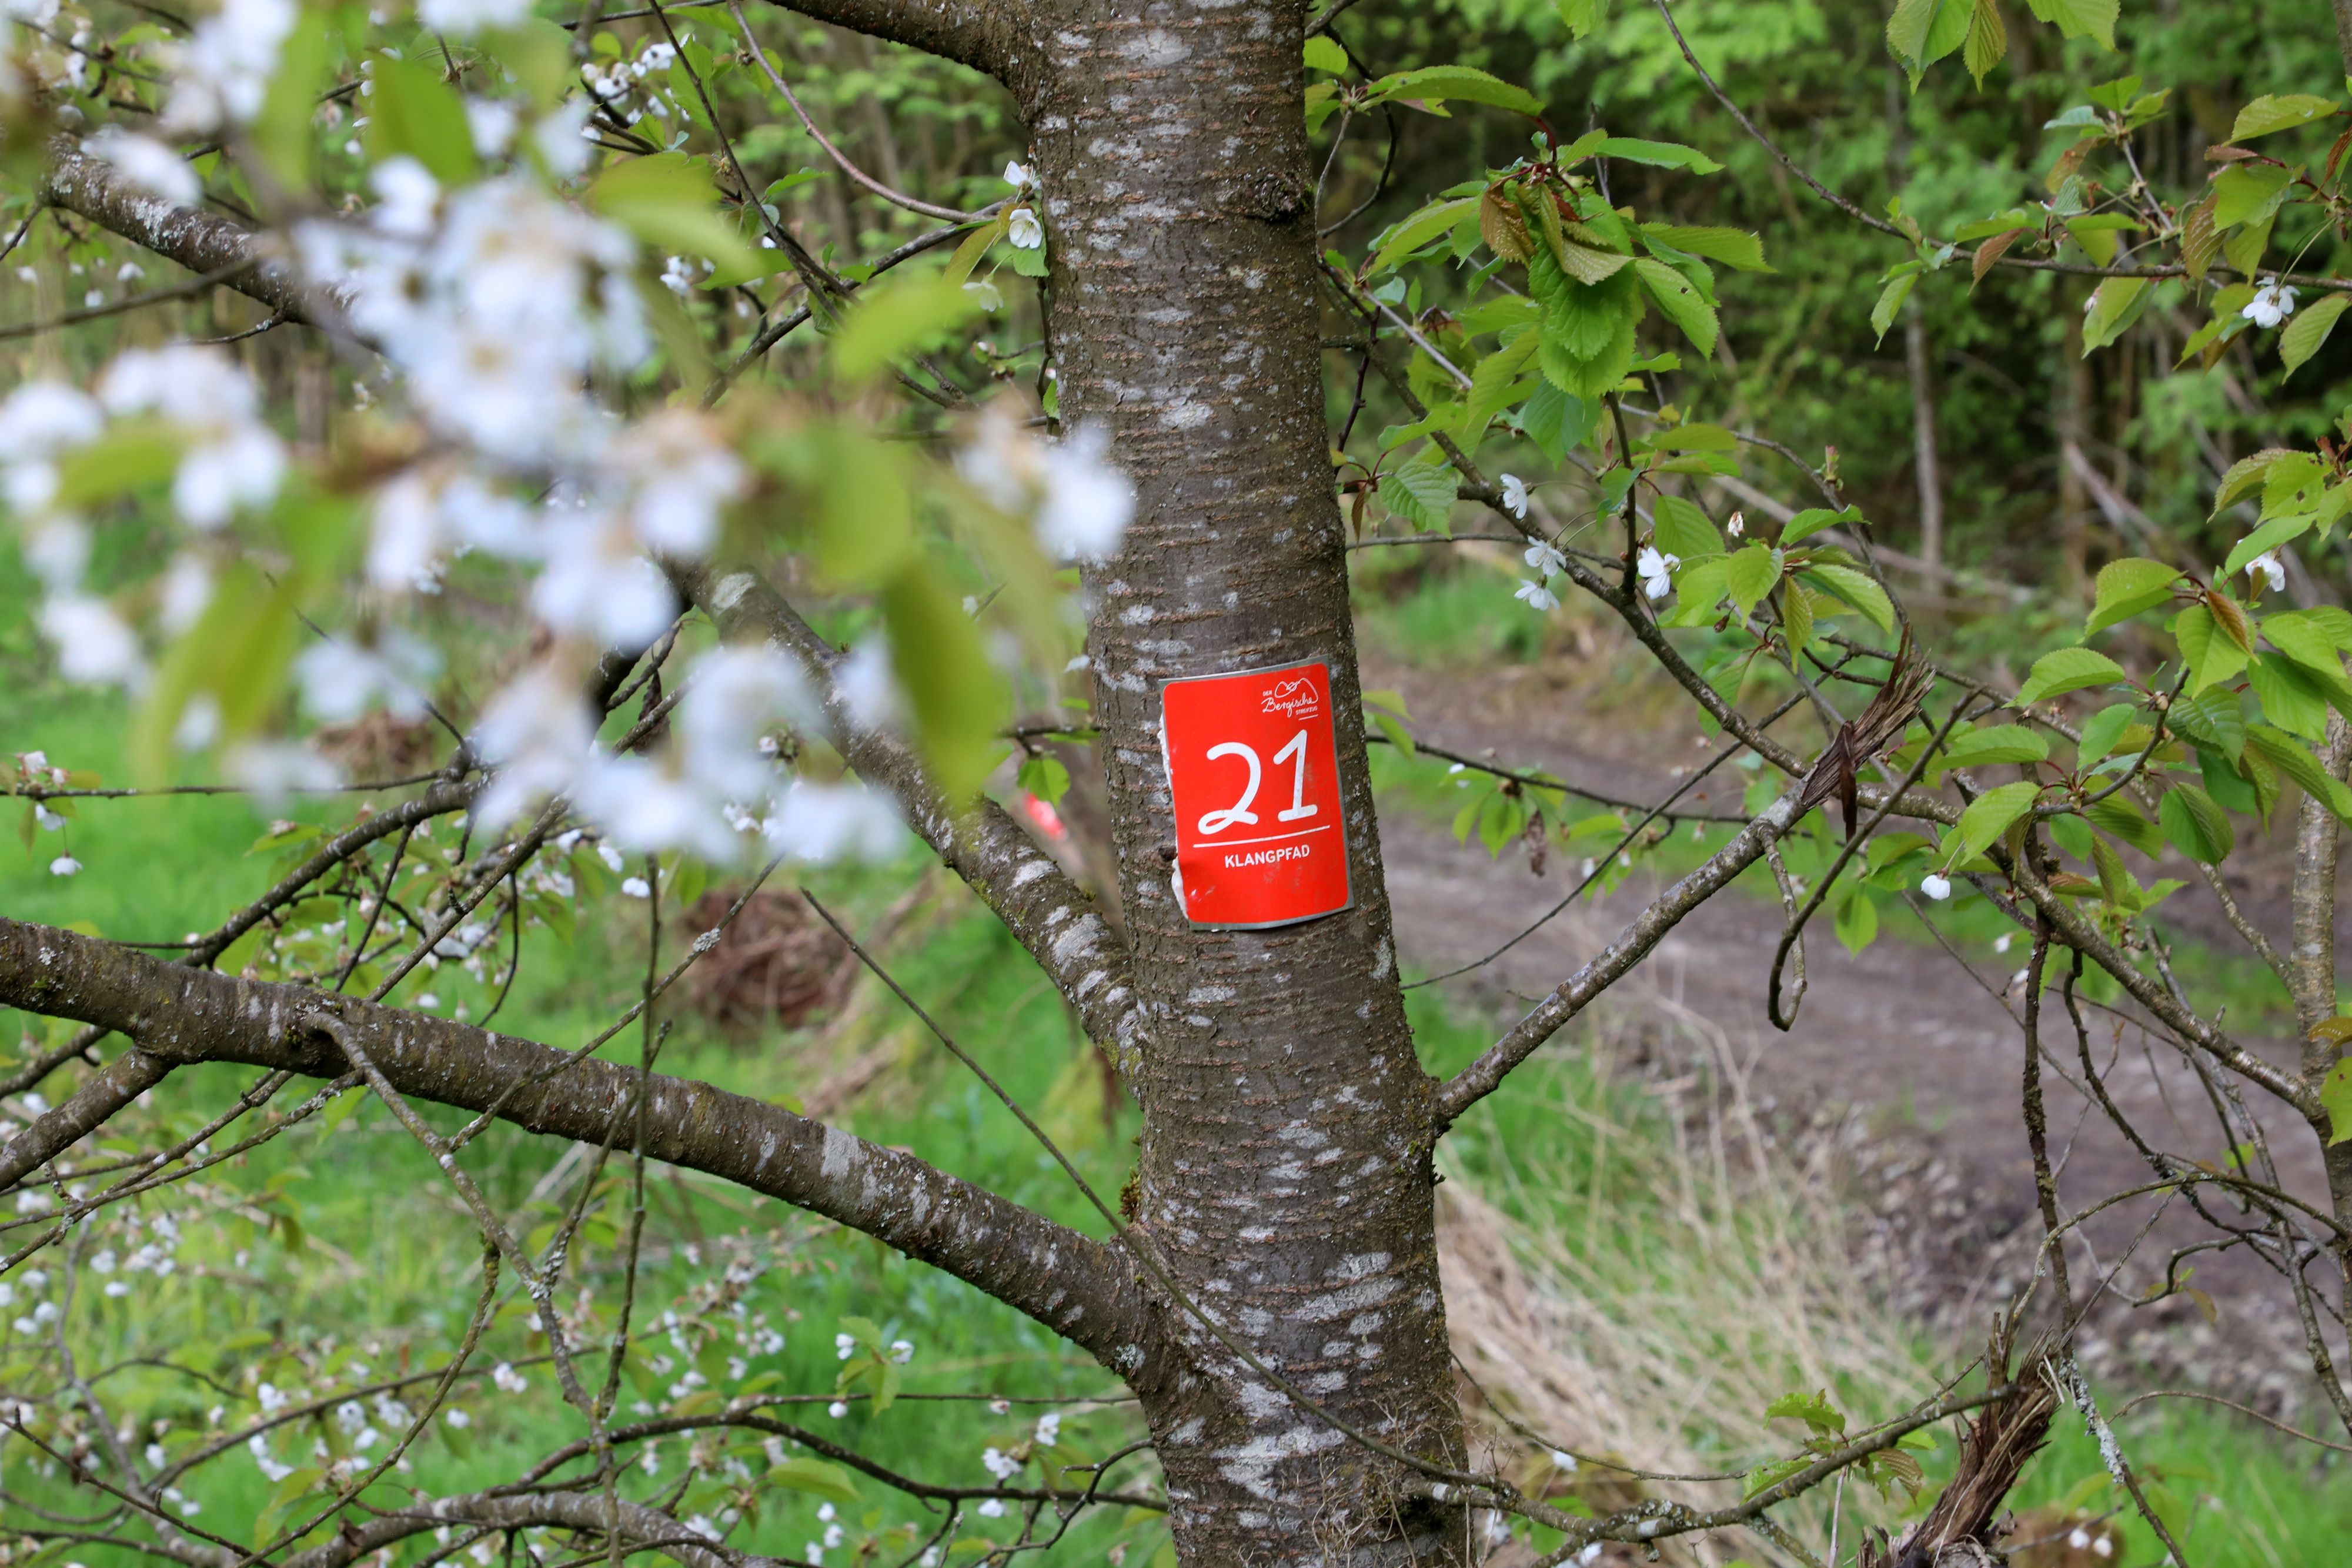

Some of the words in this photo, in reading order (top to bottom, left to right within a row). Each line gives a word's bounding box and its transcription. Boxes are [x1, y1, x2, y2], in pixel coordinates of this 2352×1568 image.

[1261, 692, 1317, 718] Bergische
[1198, 729, 1318, 835] 21
[1225, 844, 1310, 868] KLANGPFAD
